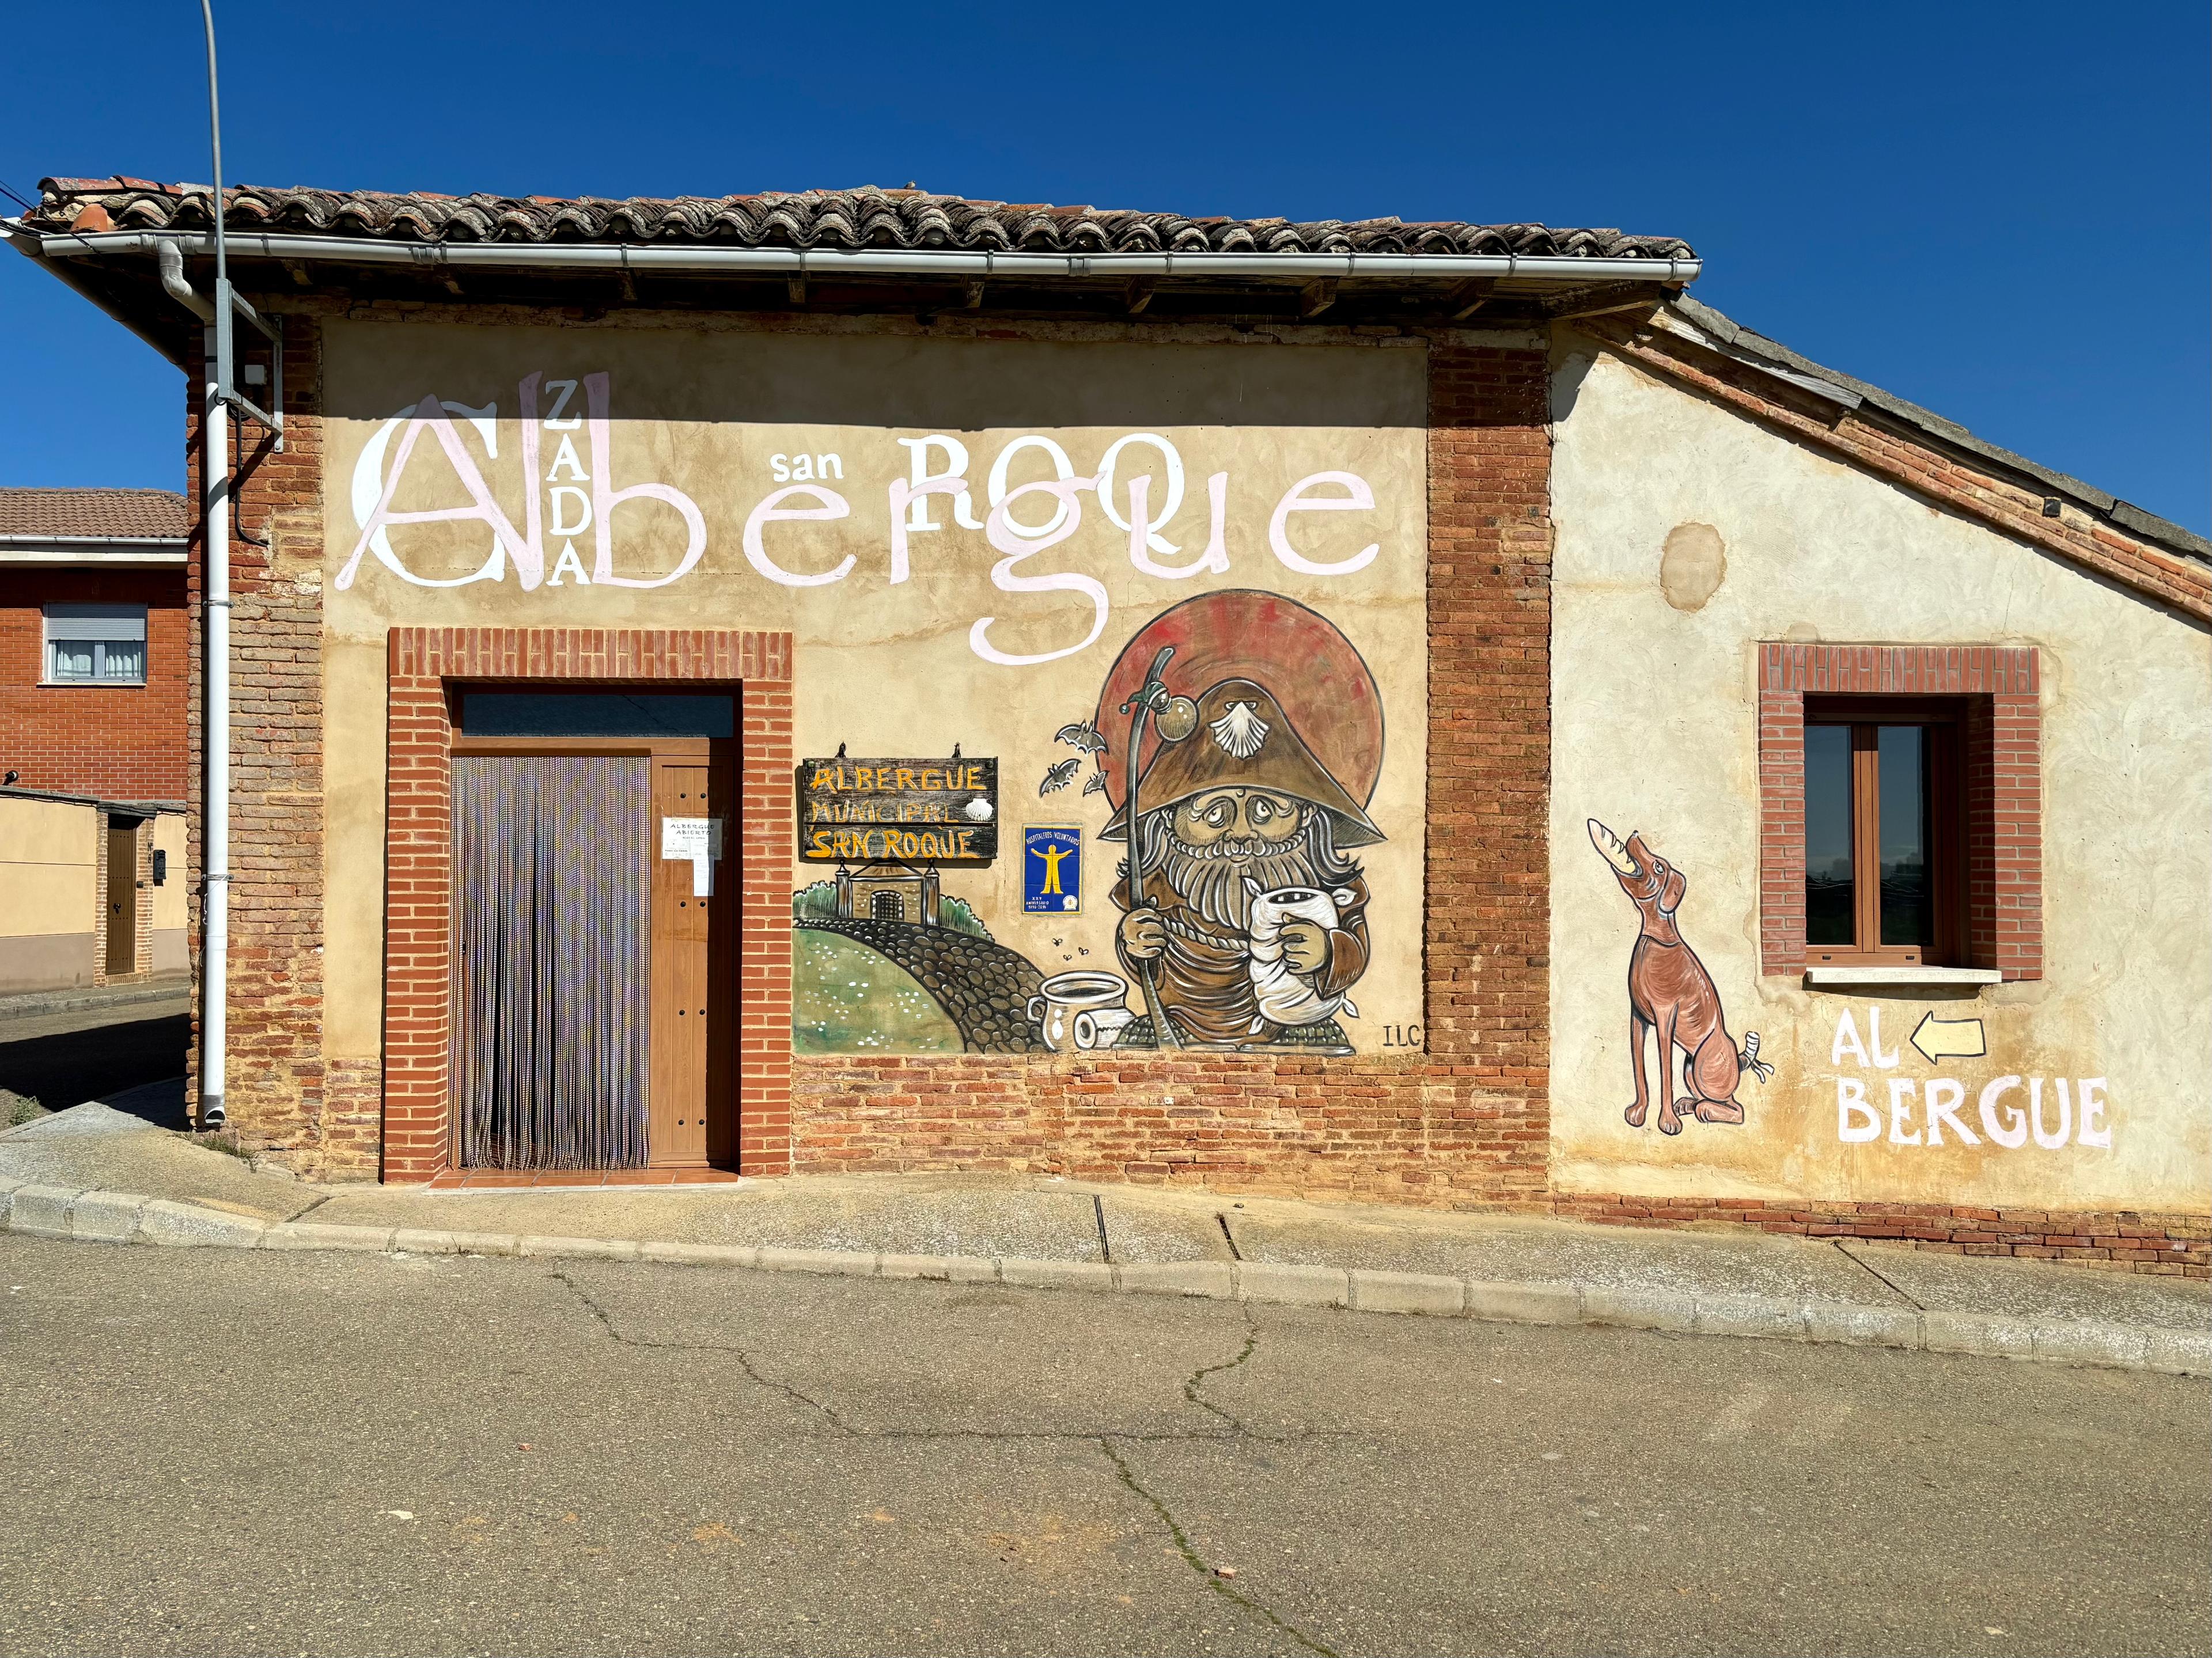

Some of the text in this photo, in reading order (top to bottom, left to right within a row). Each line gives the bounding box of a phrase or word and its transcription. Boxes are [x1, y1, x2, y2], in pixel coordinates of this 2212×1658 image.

[770, 453, 844, 482] san
[334, 370, 1379, 665] Albergue
[810, 764, 987, 793] ALBERGUE
[809, 799, 959, 830] MUNICIPAL
[806, 828, 980, 858] SAN ROQUE
[1054, 832, 1080, 846] VOLUNTARIOS
[1382, 1025, 1421, 1046] ILC
[1831, 1006, 1899, 1069] AL
[1837, 1075, 2112, 1149] BERGUE
